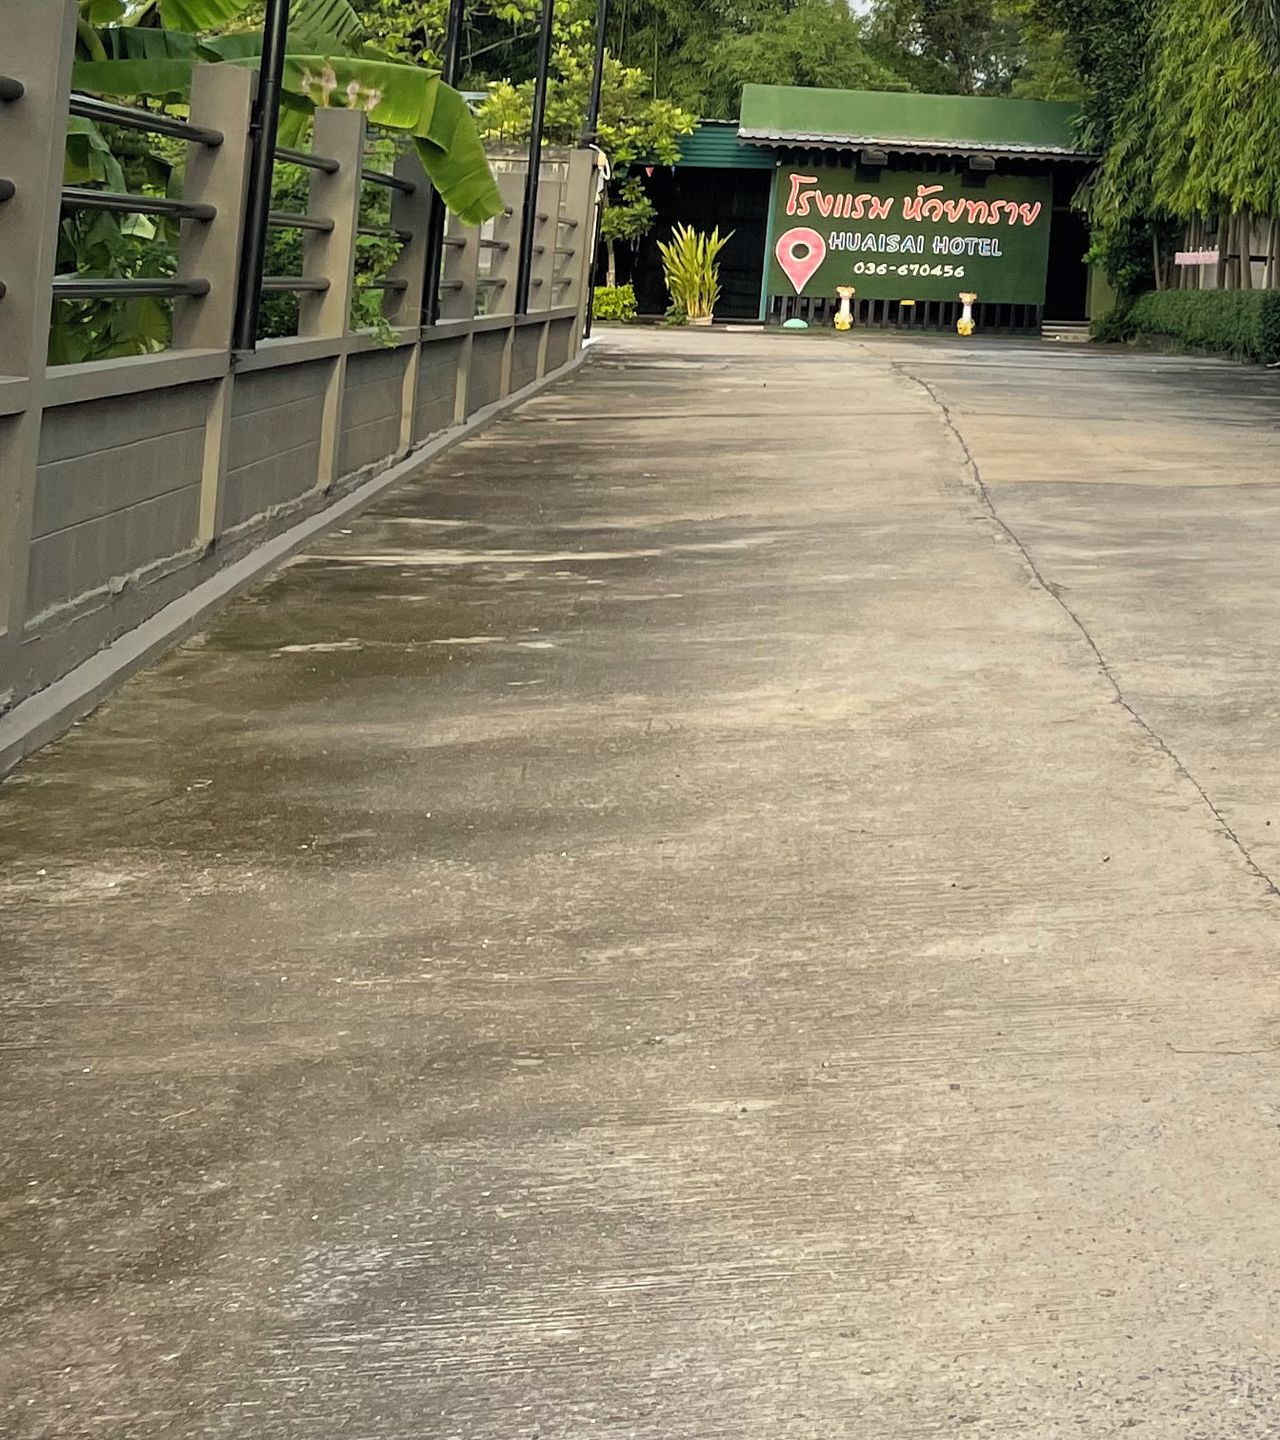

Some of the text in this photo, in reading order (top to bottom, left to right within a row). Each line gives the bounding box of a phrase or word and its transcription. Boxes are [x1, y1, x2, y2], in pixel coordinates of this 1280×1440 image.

[786, 173, 1042, 226] โรงแรม ห้วยทราย
[828, 231, 1003, 258] HUAISAI HOTEL
[853, 261, 966, 278] 036-670456
